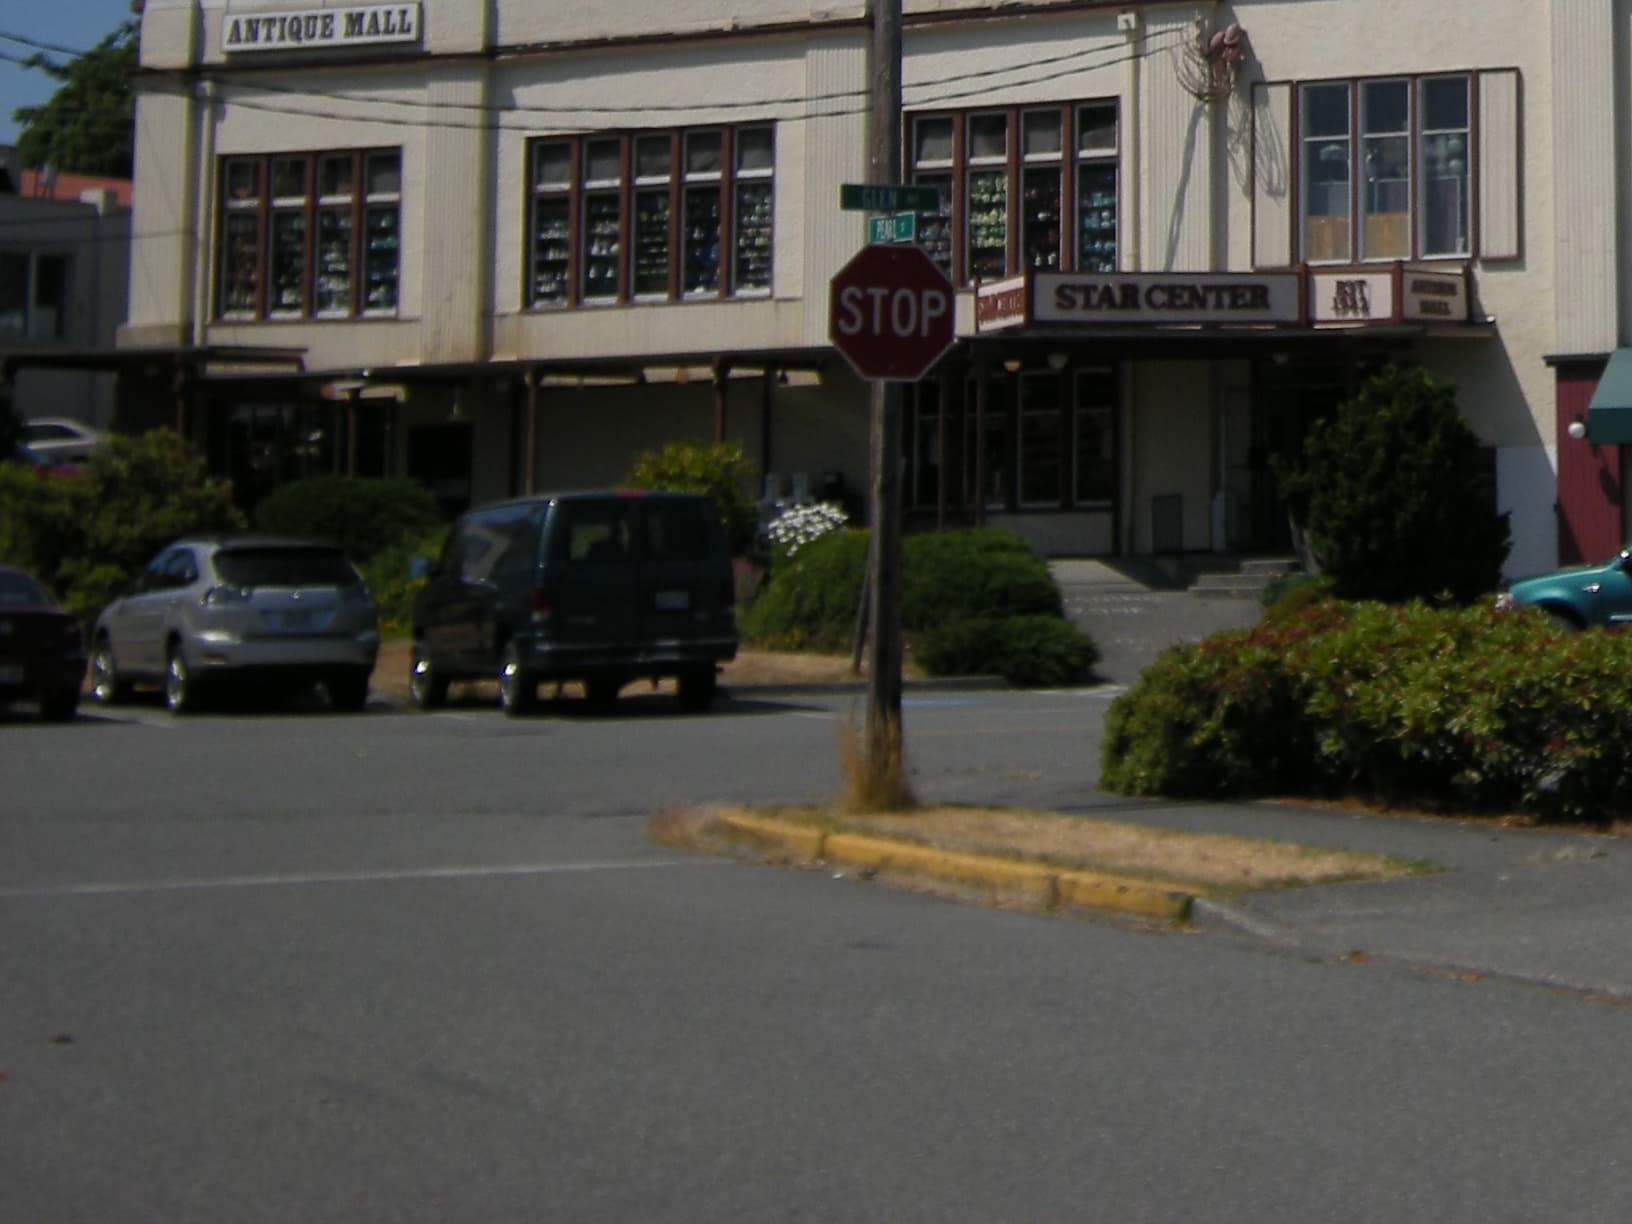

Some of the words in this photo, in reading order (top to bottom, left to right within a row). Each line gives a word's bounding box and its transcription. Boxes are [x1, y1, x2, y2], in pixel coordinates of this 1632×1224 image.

[226, 14, 335, 44] ANTIQUE
[343, 9, 412, 38] MALL
[862, 187, 898, 205] GLEN
[838, 286, 947, 338] STOP
[1055, 283, 1140, 311] STAR
[1144, 282, 1272, 311] CENTER
